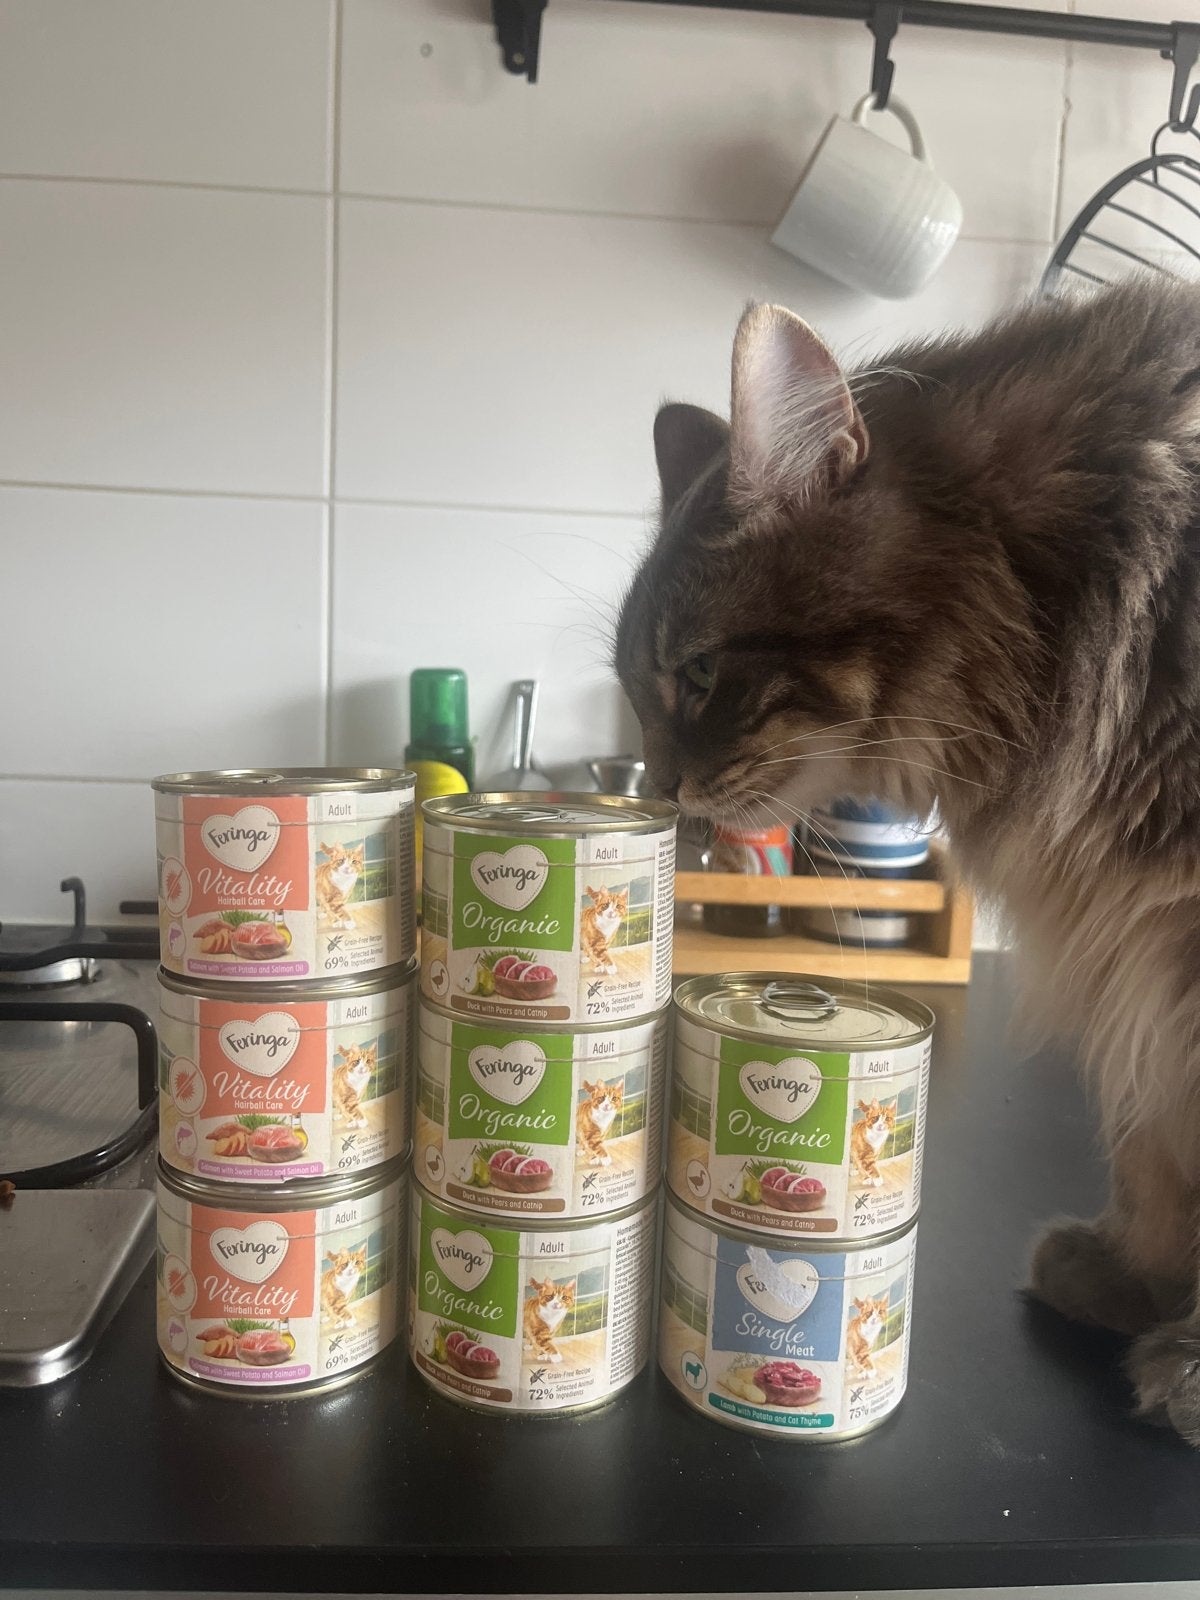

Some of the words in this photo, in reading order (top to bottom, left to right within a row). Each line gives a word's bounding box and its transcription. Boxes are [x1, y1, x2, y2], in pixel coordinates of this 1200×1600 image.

[328, 804, 351, 816] Adult
[208, 826, 271, 852] Feringa
[595, 847, 618, 860] Adult
[477, 864, 540, 891] Feringa
[198, 867, 293, 905] Vitality
[218, 896, 247, 906] Hairball
[248, 896, 265, 906] Care
[462, 901, 561, 943] Organic
[258, 966, 270, 974] and
[271, 965, 294, 973] Salmon
[325, 956, 348, 969] 69%
[346, 1005, 367, 1019] Adult
[467, 1001, 480, 1011] Duck
[481, 1004, 495, 1013] with
[496, 1006, 513, 1015] Pears
[513, 1007, 526, 1016] and
[527, 1008, 548, 1018] Catnip
[586, 1001, 610, 1015] 72%
[226, 1031, 290, 1057] Feringa
[592, 1041, 615, 1054] Adult
[475, 1058, 537, 1086] Feringa
[868, 1061, 890, 1074] Adult
[212, 1071, 311, 1109] Vitality
[746, 1074, 812, 1103] Feringa
[234, 1100, 264, 1110] Hairball
[266, 1100, 283, 1110] Care
[459, 1093, 557, 1136] Organic
[728, 1109, 831, 1152] Organic
[338, 1154, 360, 1168] 69%
[235, 1168, 252, 1176] Sweet
[274, 1167, 286, 1176] and
[287, 1166, 309, 1175] Salmon
[310, 1165, 318, 1173] Oil
[462, 1190, 476, 1200] Duck
[491, 1197, 508, 1207] Pears
[509, 1199, 521, 1208] and
[522, 1201, 543, 1210] Catnip
[581, 1192, 605, 1206] 72%
[335, 1209, 357, 1225] Adult
[730, 1207, 745, 1218] Duck
[746, 1213, 760, 1221] with
[761, 1215, 780, 1226] Pears
[780, 1219, 793, 1227] and
[794, 1220, 816, 1229] Catnip
[853, 1212, 876, 1227] 72%
[216, 1240, 279, 1265] Feringa
[540, 1241, 564, 1253] Adult
[436, 1239, 485, 1273] Feringa
[863, 1256, 882, 1271] Adult
[203, 1275, 299, 1315] Vitality
[424, 1270, 504, 1320] Organic
[223, 1305, 252, 1315] Hairball
[254, 1305, 271, 1315] Care
[735, 1312, 807, 1351] Single
[785, 1344, 815, 1357] Meat
[326, 1352, 348, 1369] 69%
[223, 1369, 240, 1378] Sweet
[241, 1370, 261, 1379] Potato
[262, 1370, 273, 1379] and
[274, 1369, 296, 1378] Salmon
[297, 1367, 305, 1375] Oil
[547, 1371, 575, 1380] Grain-Free
[575, 1367, 591, 1376] Recipe
[472, 1385, 491, 1397] Catnip
[528, 1388, 554, 1400] 72%
[555, 1382, 577, 1392] Selected
[556, 1389, 584, 1400] Ingredients
[720, 1400, 736, 1412] Lamb
[752, 1410, 773, 1421] Potato
[774, 1415, 787, 1423] and
[787, 1416, 799, 1424] Cat
[800, 1417, 822, 1427] Thyme
